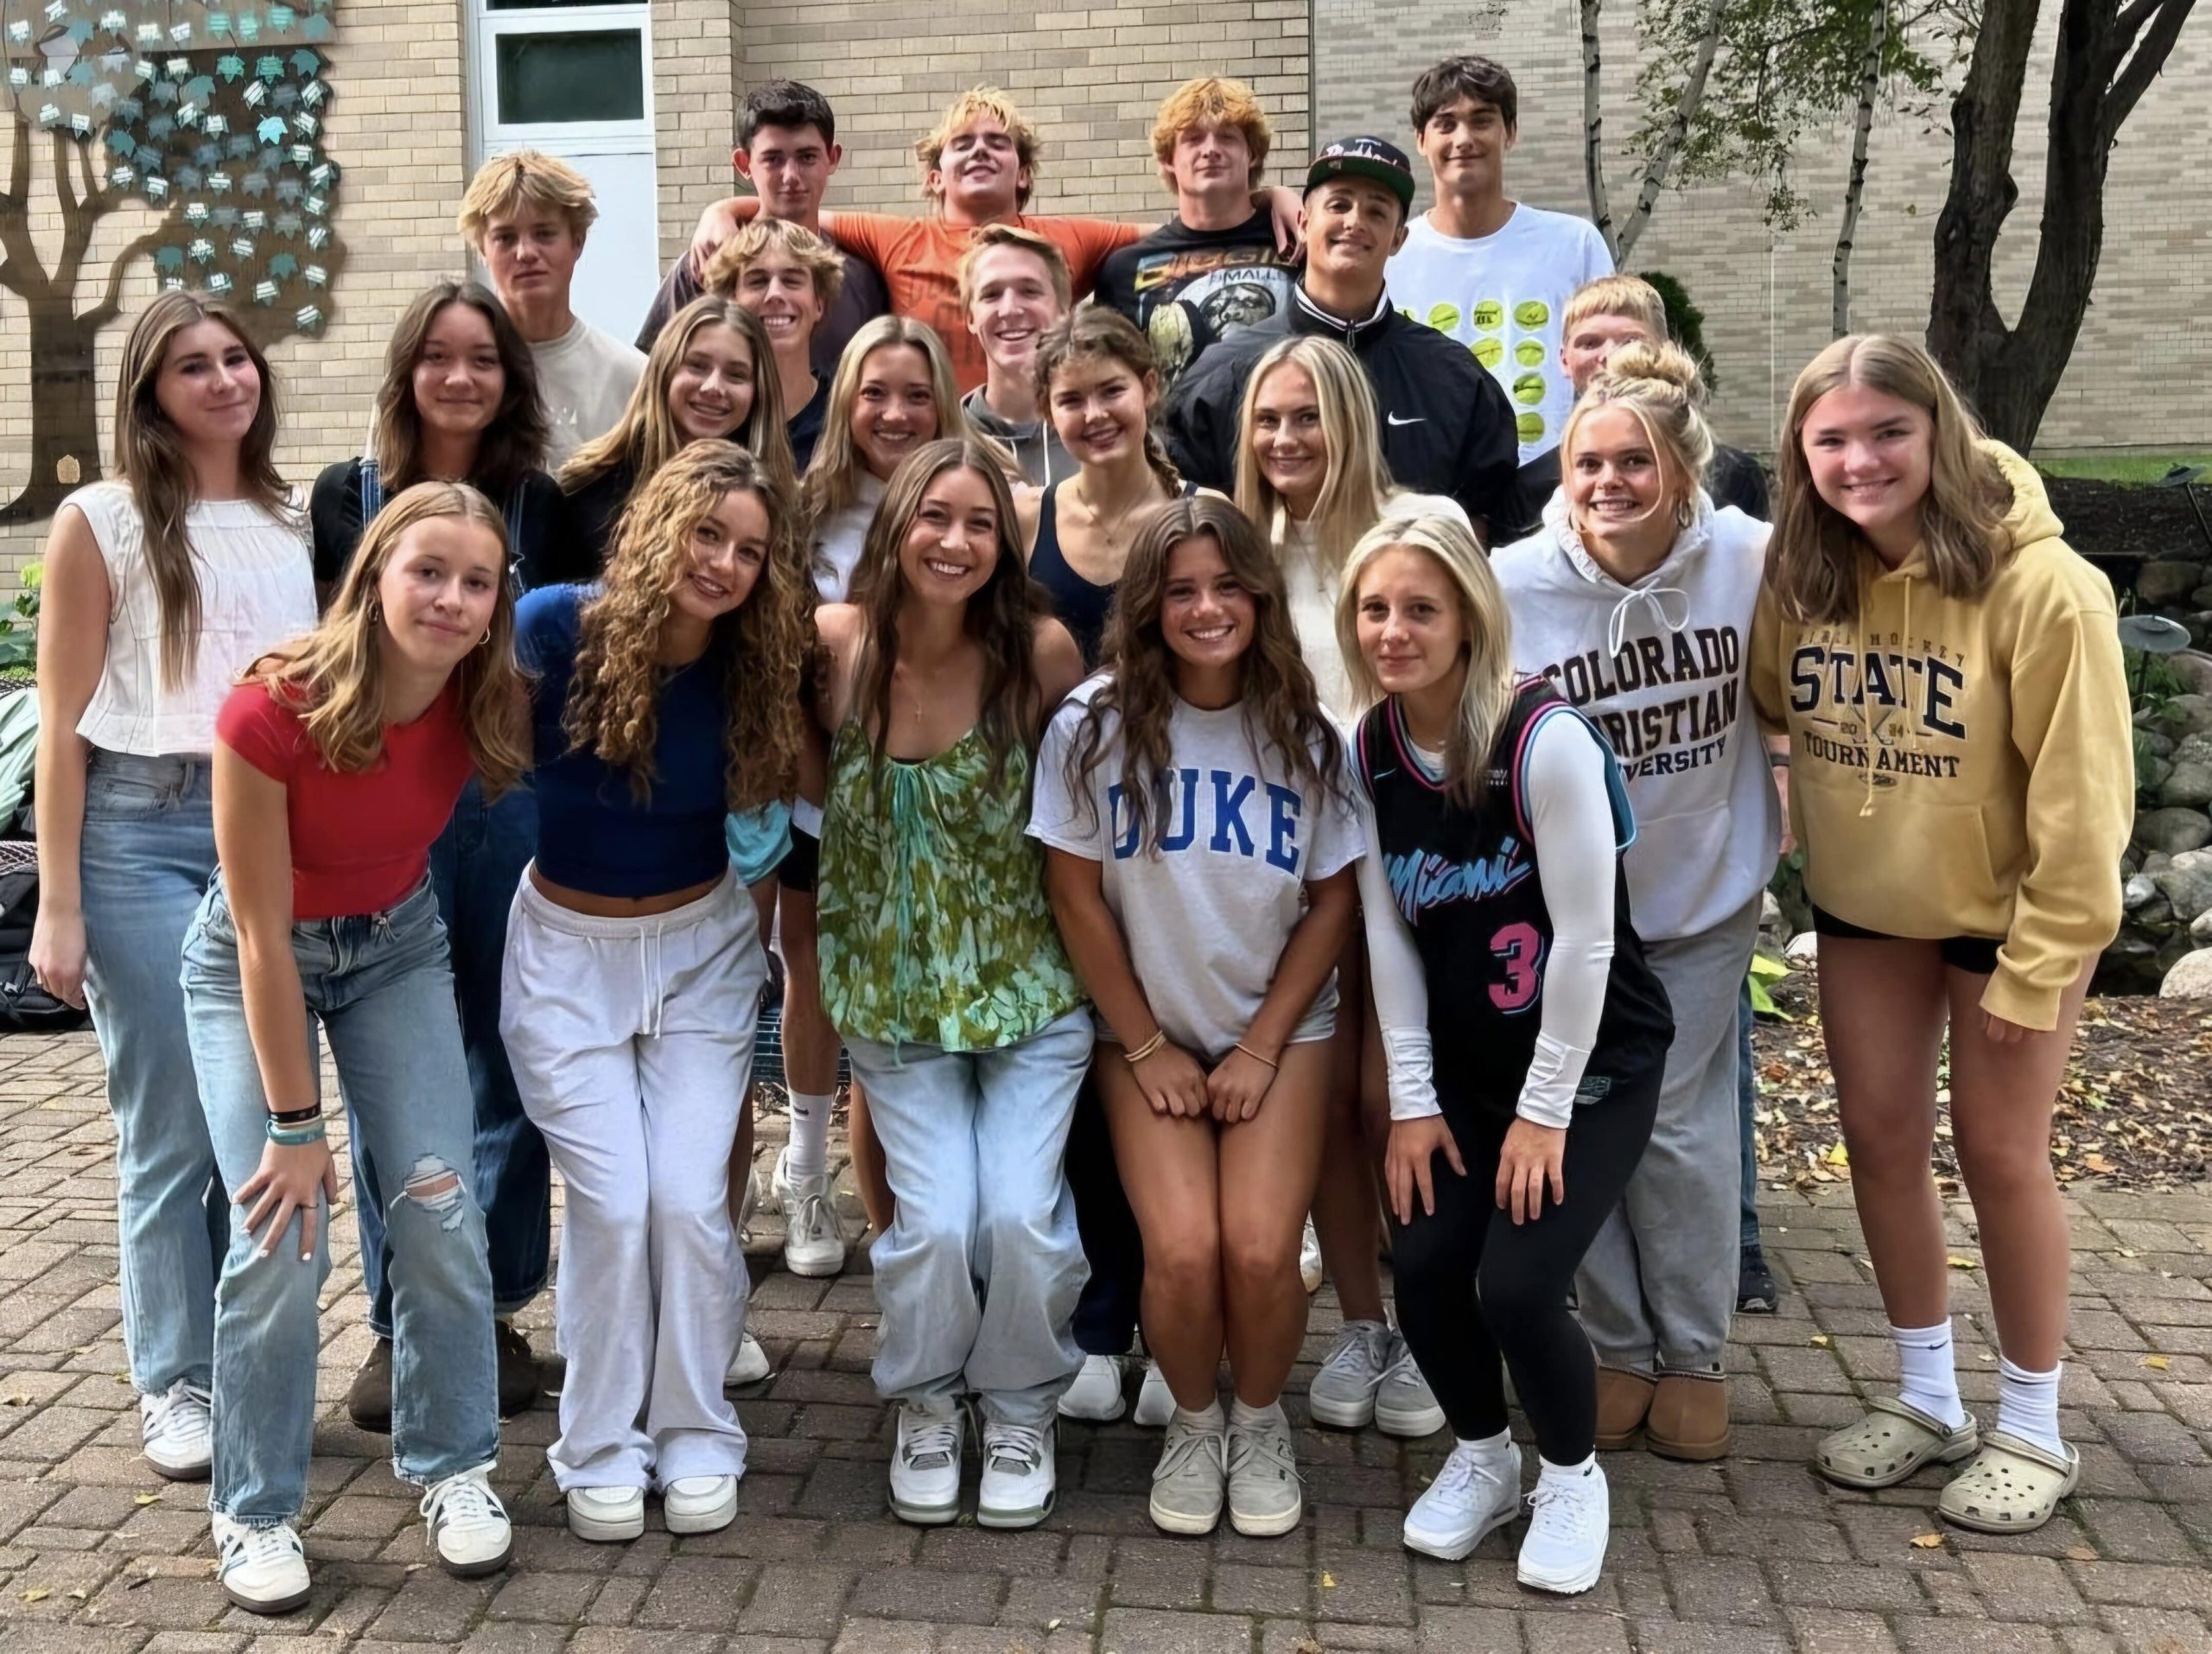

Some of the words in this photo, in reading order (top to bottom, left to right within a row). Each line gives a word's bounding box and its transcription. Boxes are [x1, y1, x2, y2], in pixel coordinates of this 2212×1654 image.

[1790, 646, 1967, 741] STATE
[1802, 730, 1960, 778] TOURNAMENT
[1108, 768, 1301, 875] DUKE
[1383, 836, 1534, 926] Miami
[1488, 922, 1544, 1015] 3
